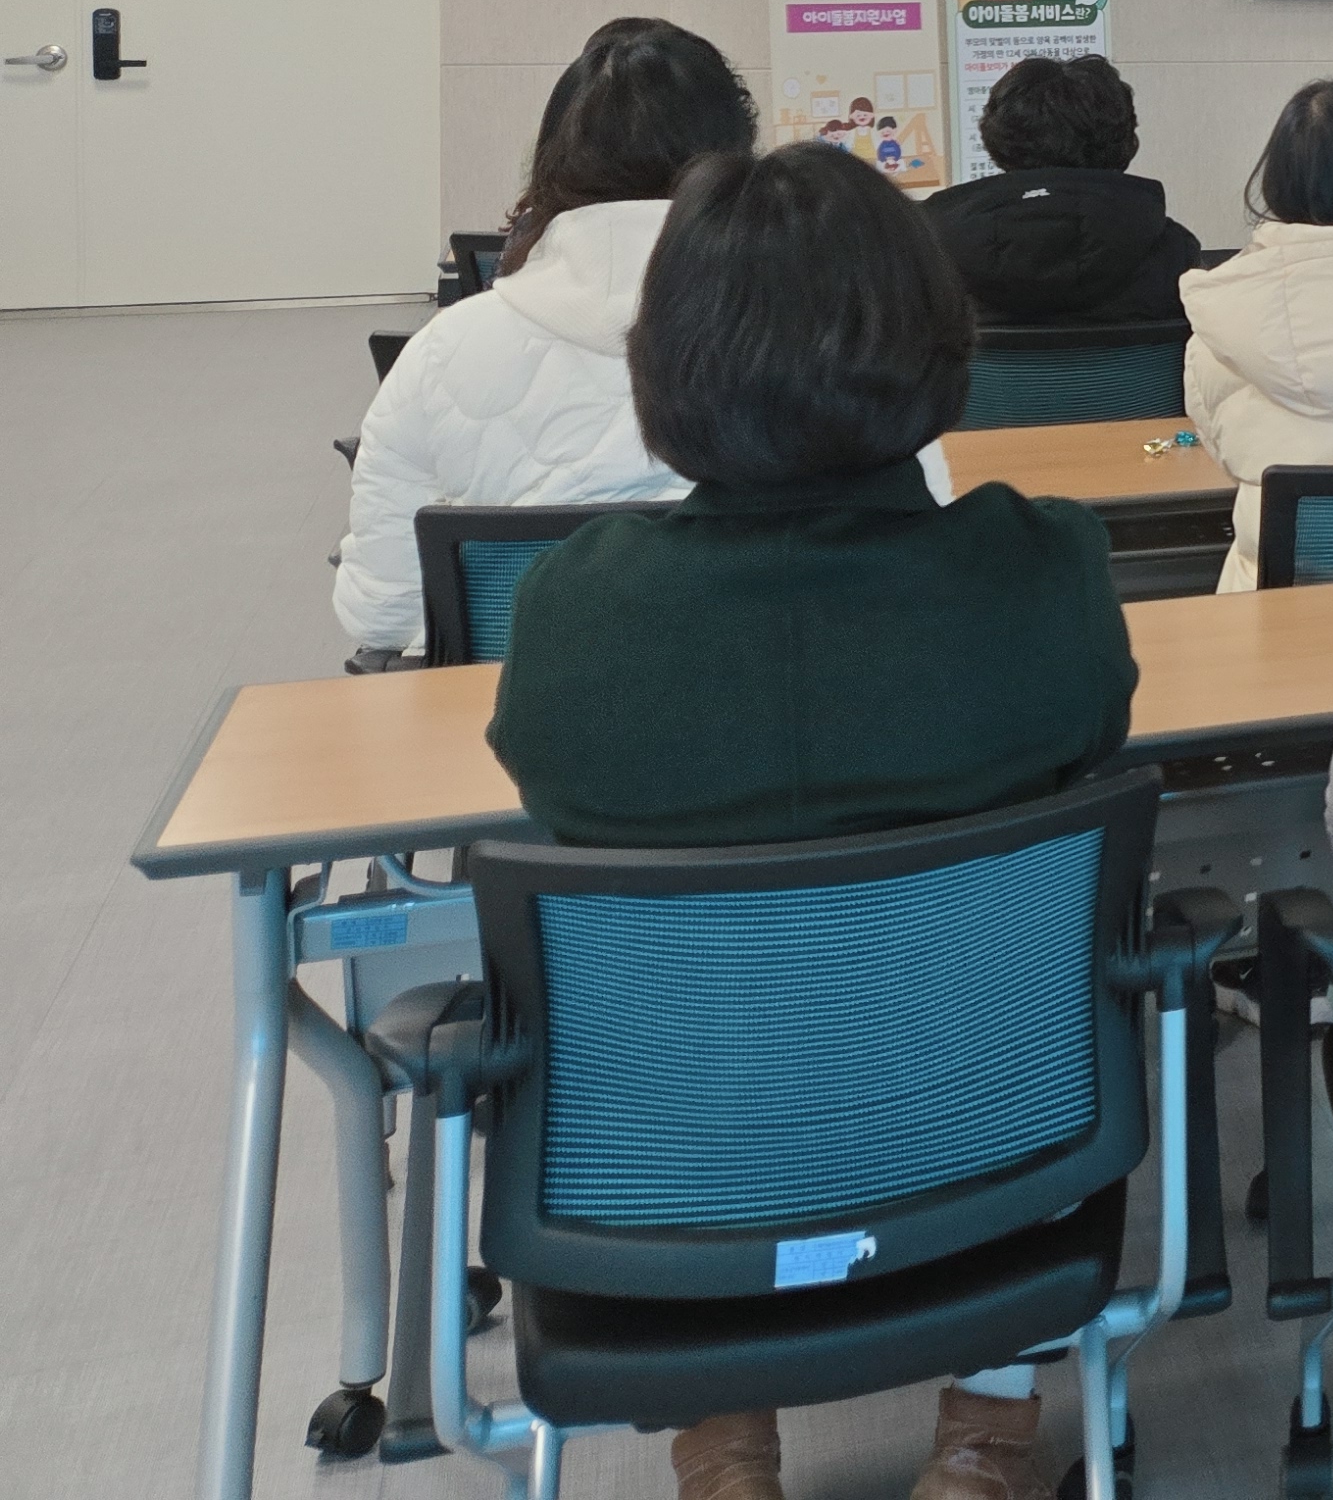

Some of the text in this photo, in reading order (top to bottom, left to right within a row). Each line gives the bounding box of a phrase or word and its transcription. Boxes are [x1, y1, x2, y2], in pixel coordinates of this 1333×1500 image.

[802, 9, 907, 27] 아이돌봄지원사업
[968, 4, 1091, 23] 아이돌봄 서비스란?
